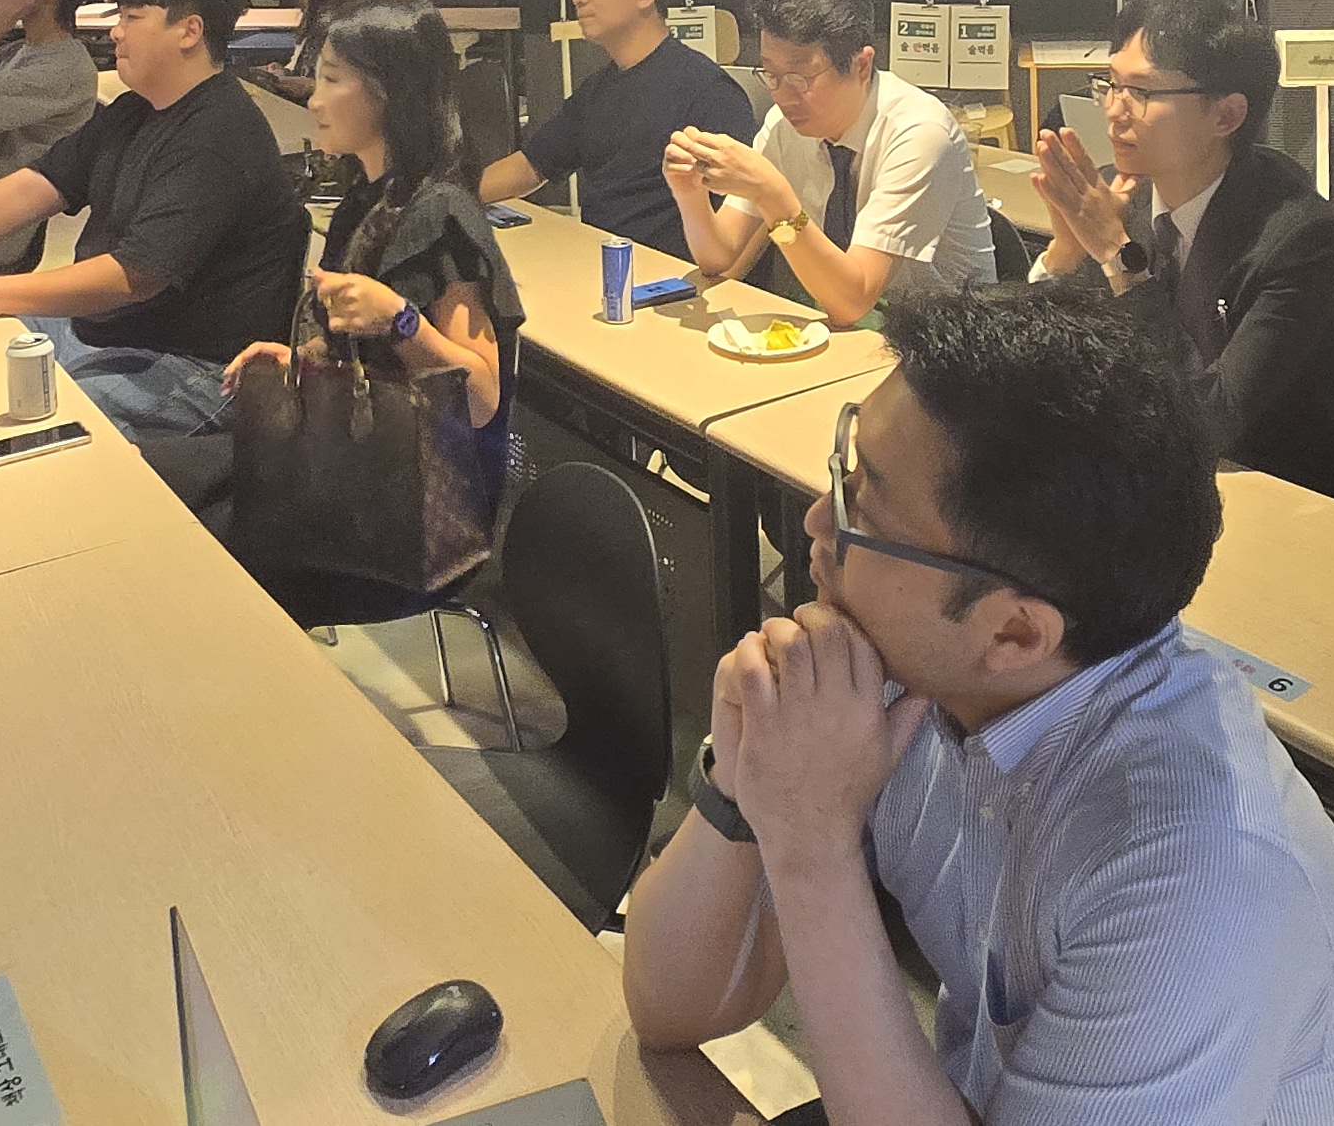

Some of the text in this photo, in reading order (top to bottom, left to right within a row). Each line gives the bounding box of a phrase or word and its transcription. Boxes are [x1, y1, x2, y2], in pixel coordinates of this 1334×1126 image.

[899, 21, 909, 35] 2
[959, 24, 969, 38] 1
[900, 41, 910, 53] 술
